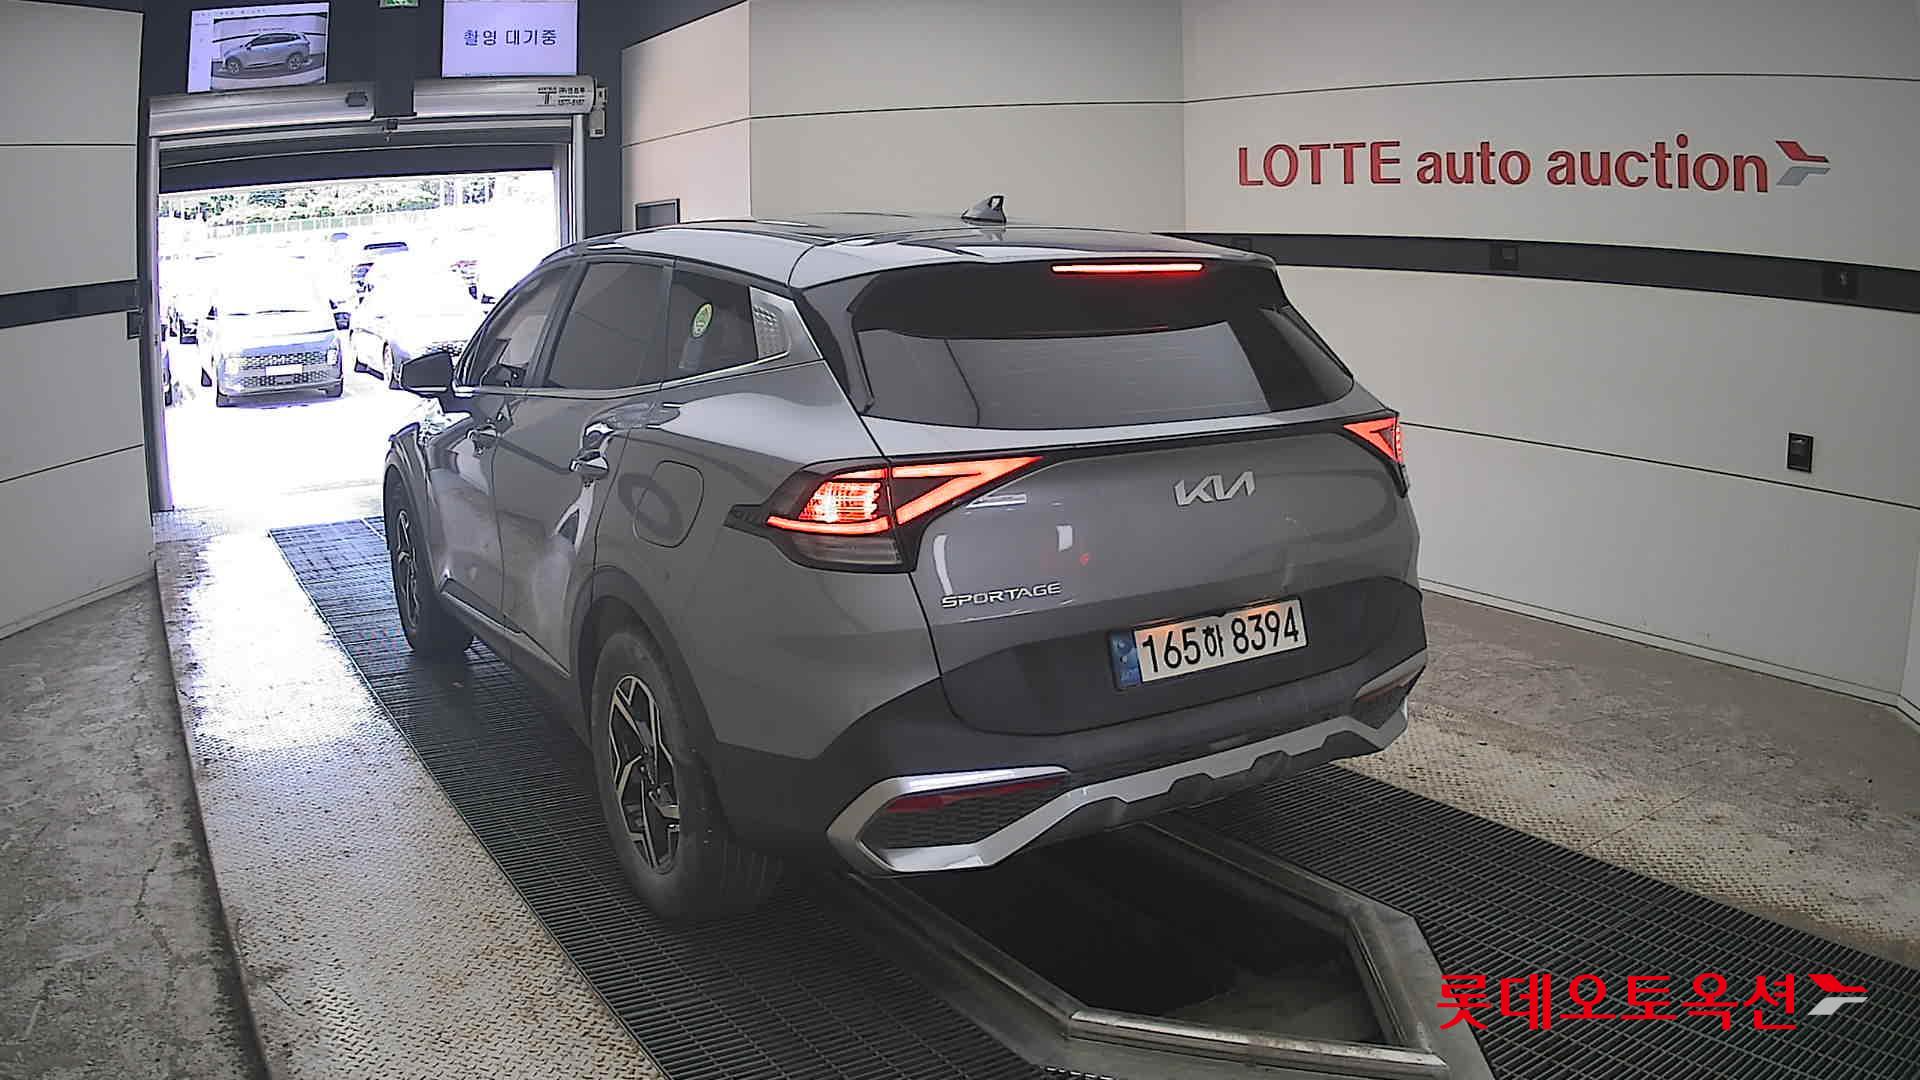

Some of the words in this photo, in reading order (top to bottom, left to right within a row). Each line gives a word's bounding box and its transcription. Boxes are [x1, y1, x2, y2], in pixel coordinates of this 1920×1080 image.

[505, 29, 558, 46] 대기중
[1238, 140, 1401, 187] LOTTE
[1416, 141, 1532, 186] auto
[1547, 133, 1769, 193] auction
[1173, 471, 1256, 506] KIA
[941, 582, 1062, 609] SPORTAGE
[1142, 624, 1225, 673] 165하
[1230, 606, 1299, 655] 8394
